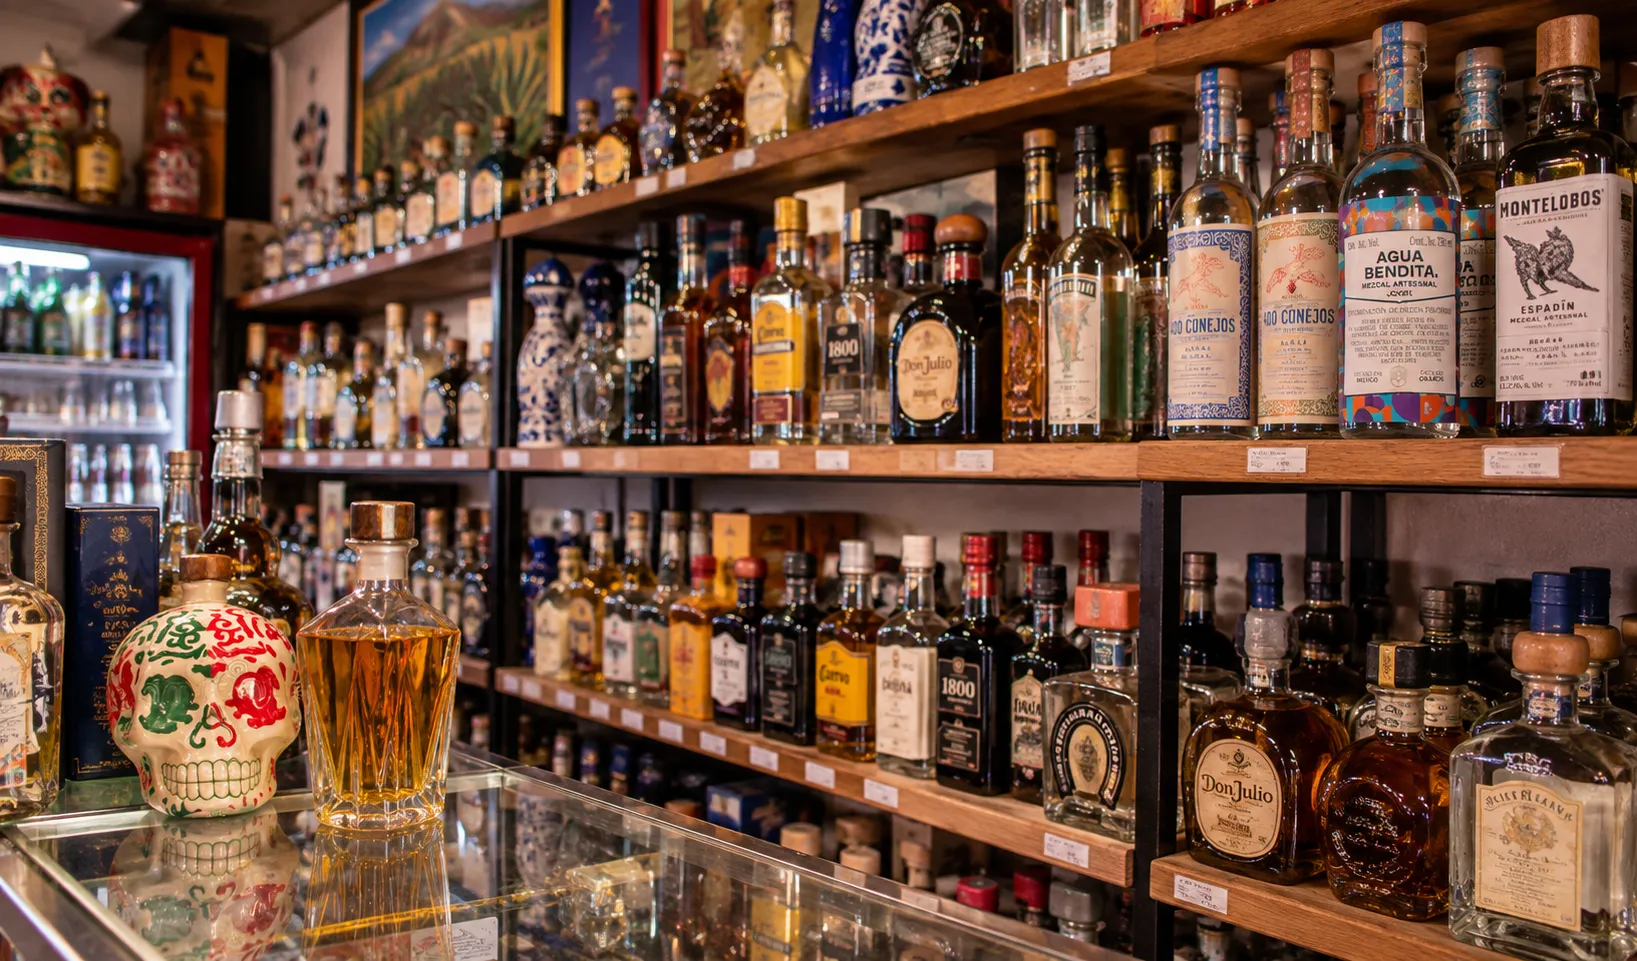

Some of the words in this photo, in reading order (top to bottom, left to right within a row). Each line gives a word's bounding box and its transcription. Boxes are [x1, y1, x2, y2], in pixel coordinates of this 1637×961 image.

[1376, 249, 1424, 264] AGUA
[1185, 317, 1236, 333] CONEJOS
[1281, 307, 1336, 324] CONEJOS
[828, 339, 859, 358] 1800
[922, 355, 953, 375] Julio
[942, 677, 976, 699] 1800
[1201, 774, 1233, 796] Don
[1231, 780, 1274, 804] Julio
